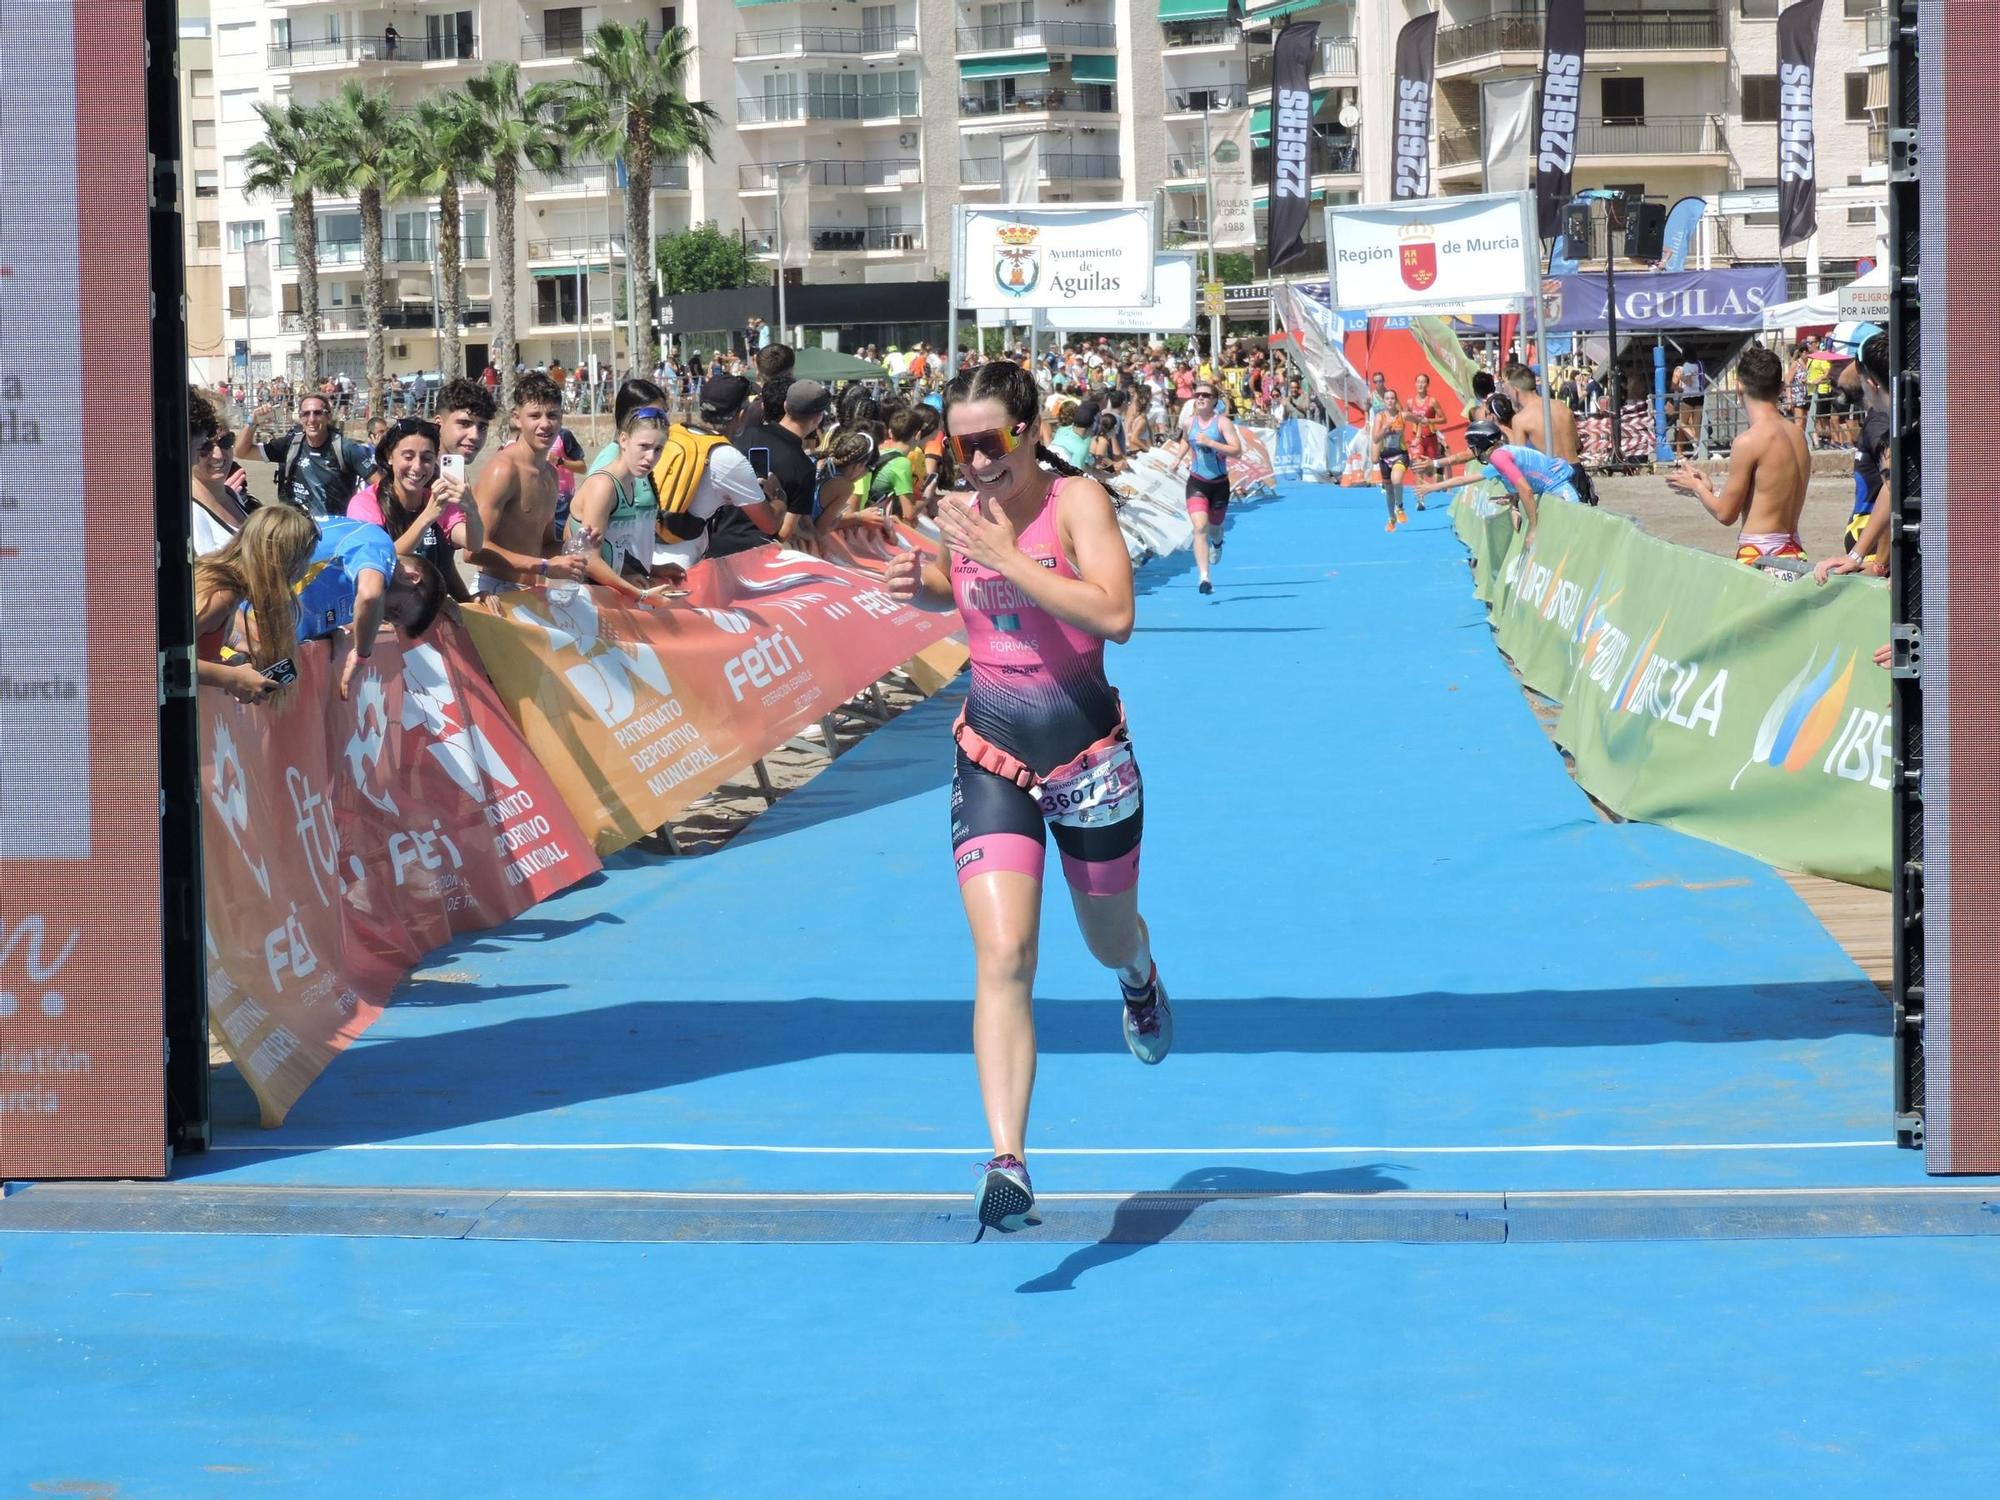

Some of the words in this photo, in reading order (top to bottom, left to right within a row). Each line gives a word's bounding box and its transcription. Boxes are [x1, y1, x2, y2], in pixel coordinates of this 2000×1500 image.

[1539, 53, 1581, 174] 226ERS
[1780, 63, 1813, 182] 226ERS
[1276, 89, 1309, 198] 226ERS
[1396, 79, 1430, 197] 226ERS
[1223, 222, 1245, 232] 1988
[1049, 247, 1122, 262] Ayuntamiento
[1339, 245, 1393, 264] Región
[1442, 239, 1462, 255] de
[1466, 235, 1520, 253] Murcia
[1079, 260, 1093, 272] de
[1049, 271, 1121, 298] Águilas
[1852, 293, 1889, 302] PELIGRO
[1841, 306, 1858, 315] POR
[990, 640, 1040, 652] FORMAS
[613, 698, 683, 749] PATRONATO
[630, 722, 700, 773] DEPORTIVO
[646, 744, 719, 797] MUNICIPAL
[1042, 781, 1097, 812] 3607
